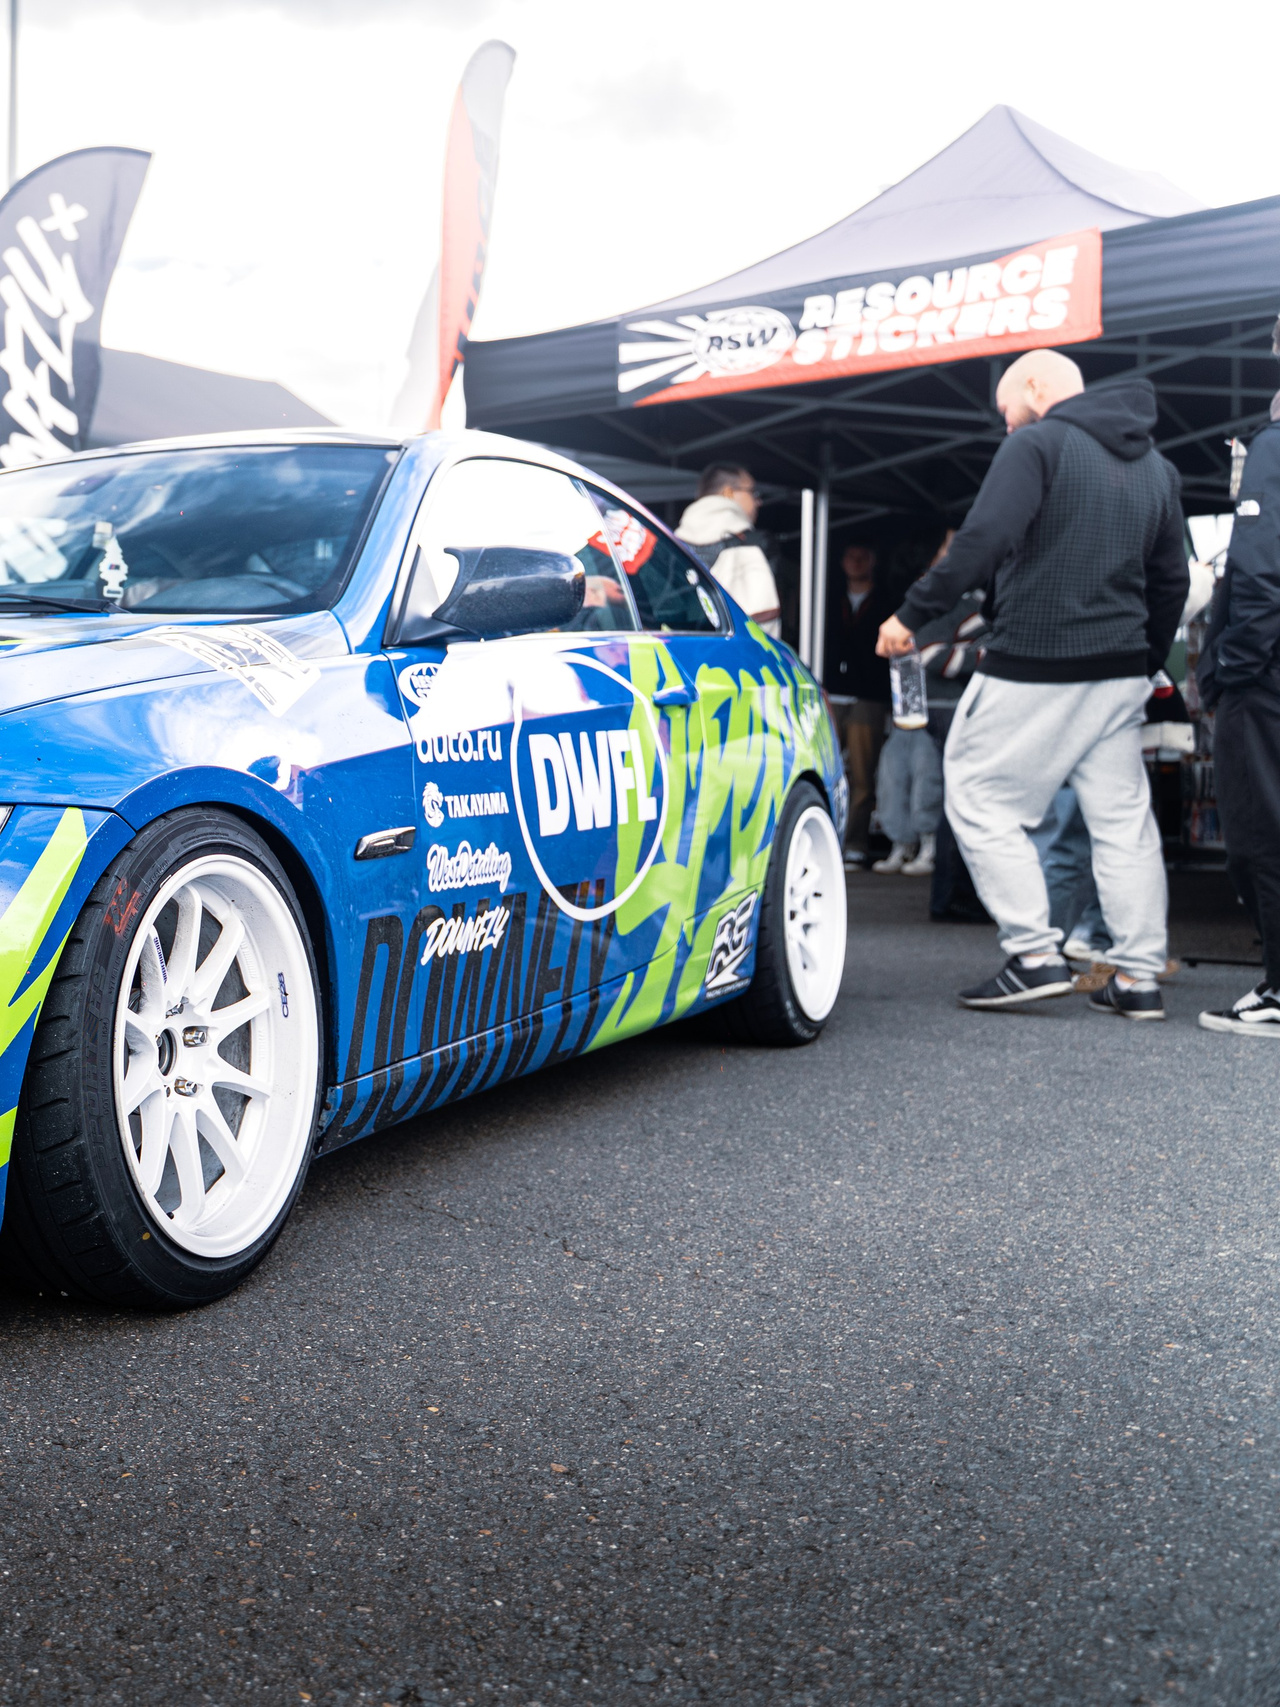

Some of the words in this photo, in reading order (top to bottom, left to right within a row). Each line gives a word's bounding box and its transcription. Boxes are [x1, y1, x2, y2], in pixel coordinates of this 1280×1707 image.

[798, 244, 1079, 331] RESOURCE
[706, 325, 778, 355] RSW
[790, 286, 1071, 365] STICKERS
[416, 730, 503, 764] auto.ru
[445, 792, 510, 818] TAKAYAMA
[528, 729, 658, 838] DWFL
